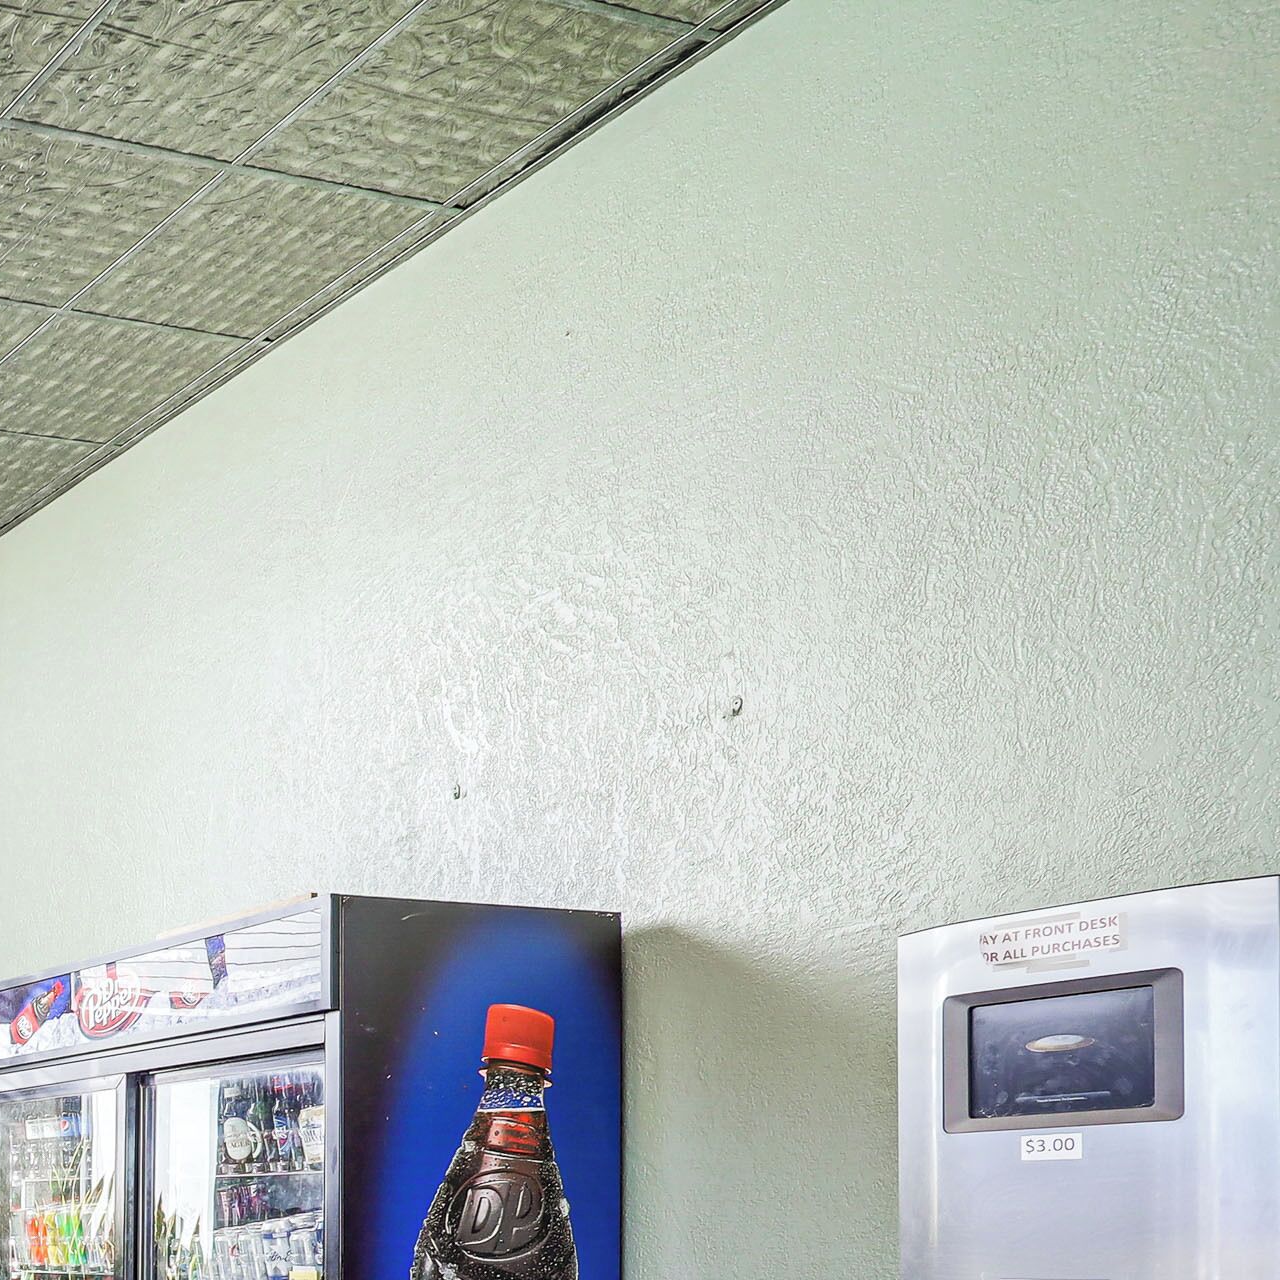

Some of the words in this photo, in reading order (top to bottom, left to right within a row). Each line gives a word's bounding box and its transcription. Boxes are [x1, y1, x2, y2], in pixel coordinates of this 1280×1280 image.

[1002, 931, 1020, 943] AT
[1024, 922, 1074, 939] FRONT
[1079, 915, 1118, 932] DESK
[1003, 949, 1027, 960] ALL
[1032, 934, 1120, 956] PURCHASES
[1025, 1137, 1076, 1155] $3.00
